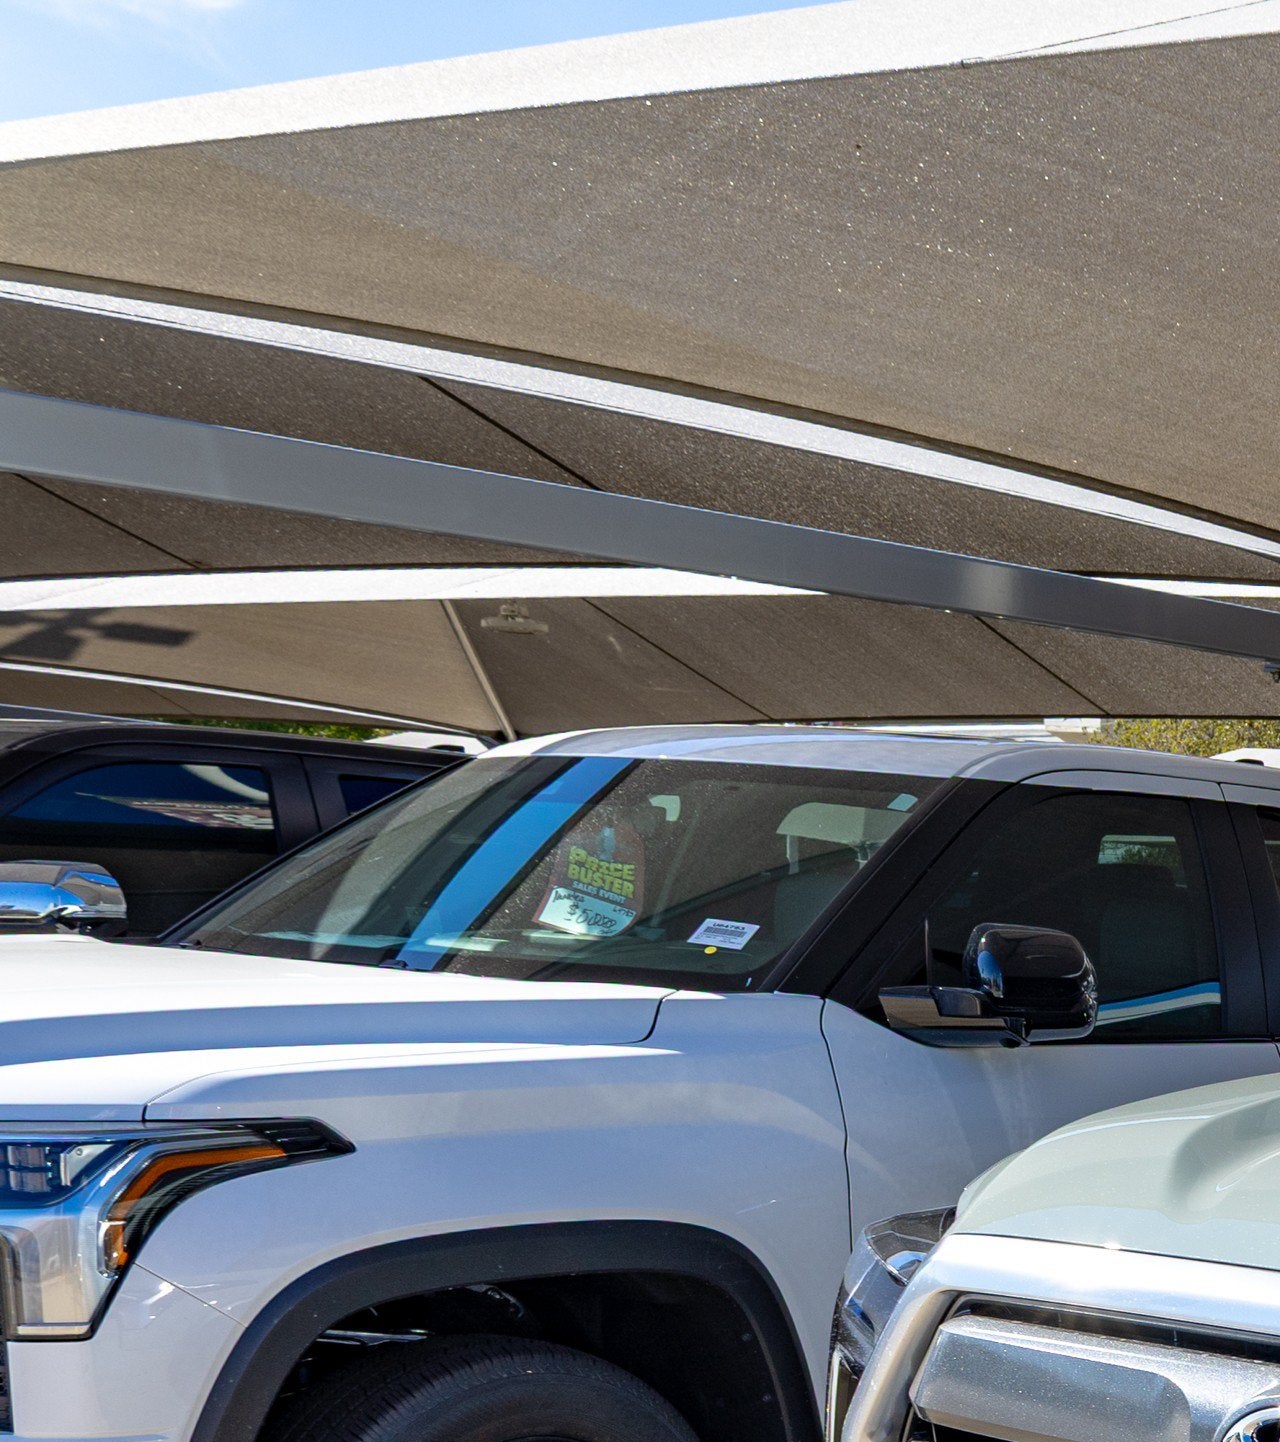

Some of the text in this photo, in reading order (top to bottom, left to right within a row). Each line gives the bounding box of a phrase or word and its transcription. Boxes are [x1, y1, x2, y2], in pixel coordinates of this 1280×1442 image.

[567, 863, 635, 898] BUSTER
[568, 846, 635, 881] PRICE
[572, 881, 626, 904] SALES EVENT
